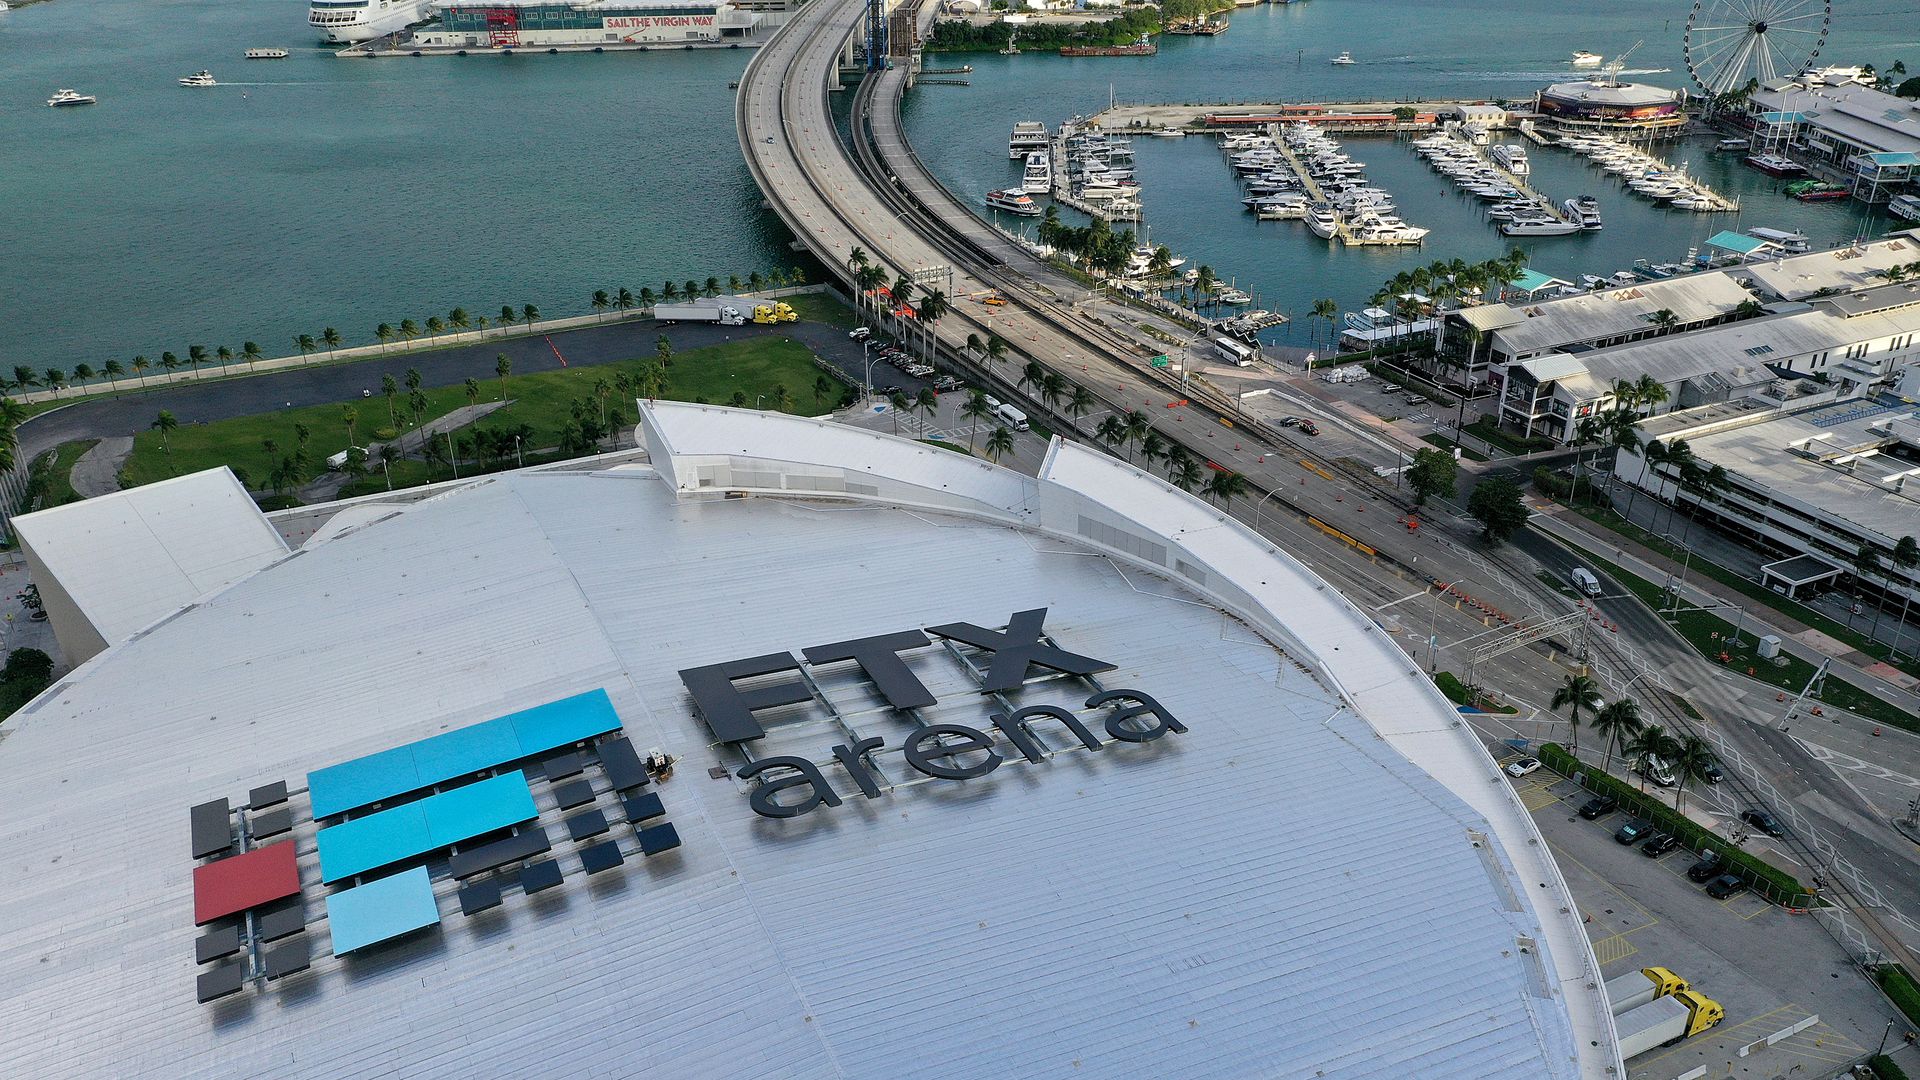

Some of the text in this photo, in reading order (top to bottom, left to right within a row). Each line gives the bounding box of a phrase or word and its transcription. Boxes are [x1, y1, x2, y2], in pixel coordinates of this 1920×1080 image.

[607, 16, 713, 28] SAIL THE VIRGIN WAY
[678, 607, 1118, 744] FTX
[736, 689, 1188, 818] arena
